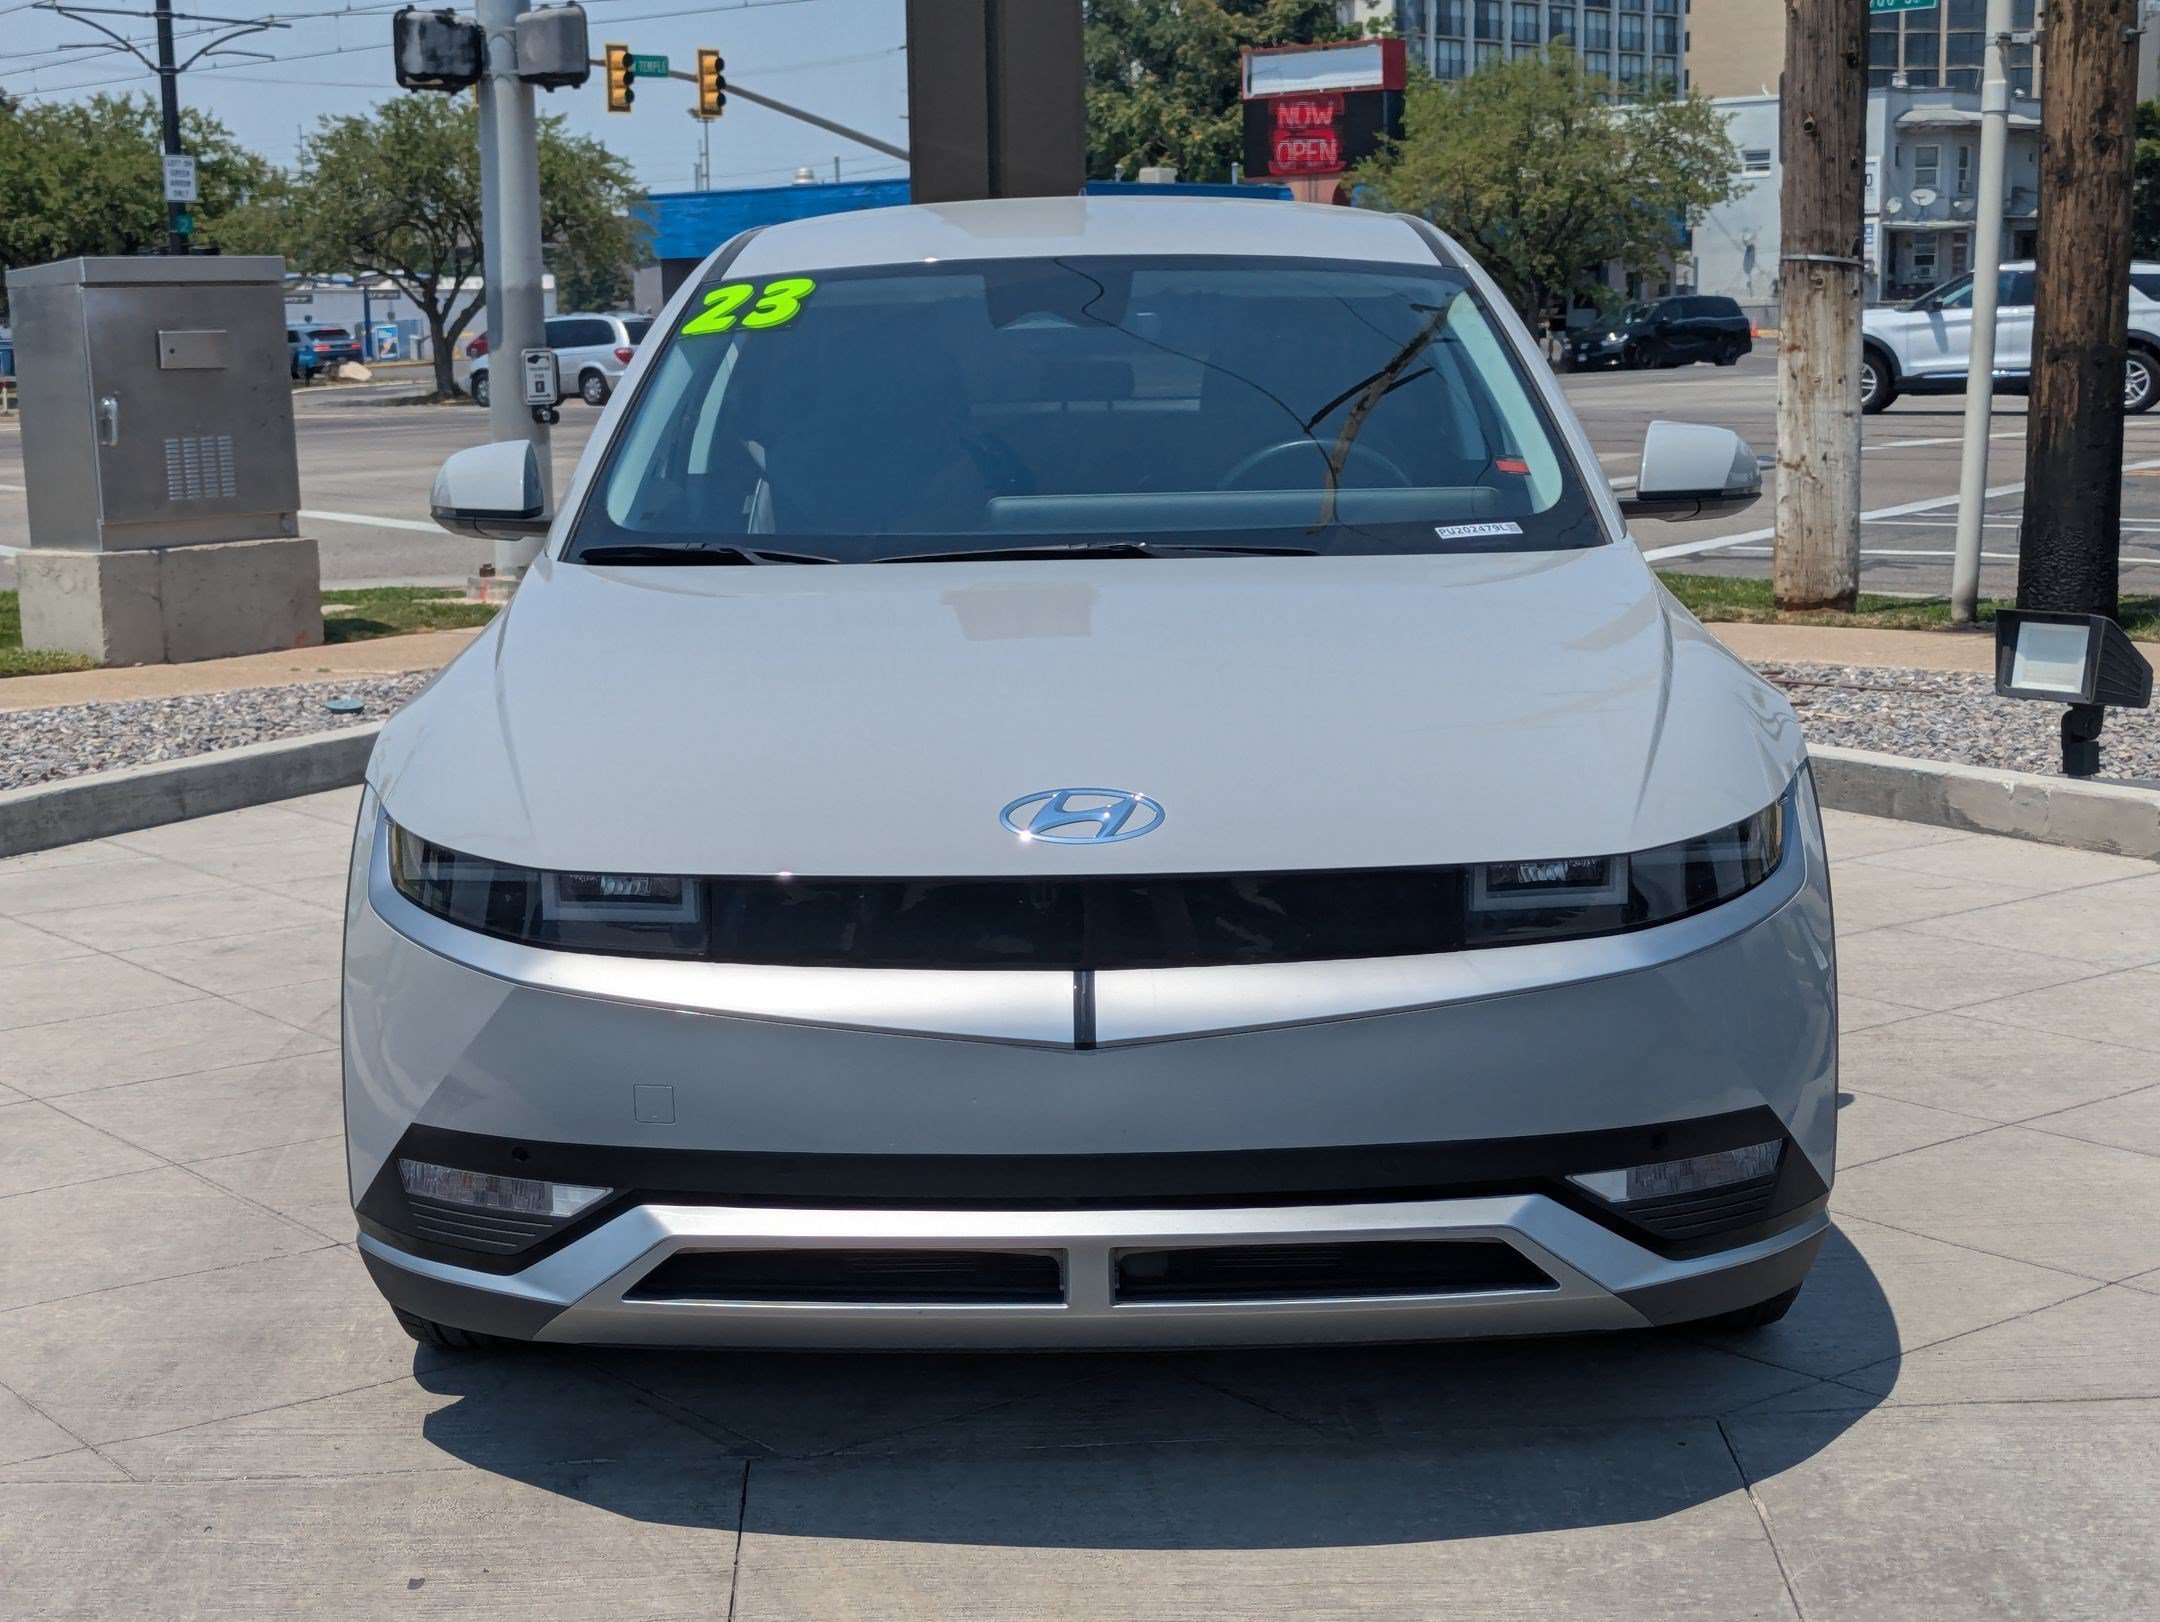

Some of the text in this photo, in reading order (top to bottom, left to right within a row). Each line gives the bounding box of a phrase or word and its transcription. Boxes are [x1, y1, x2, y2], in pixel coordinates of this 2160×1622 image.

[1277, 102, 1334, 127] NOW
[1276, 139, 1337, 168] OPEN
[681, 278, 816, 334] 23
[1440, 524, 1508, 536] PU202479L
